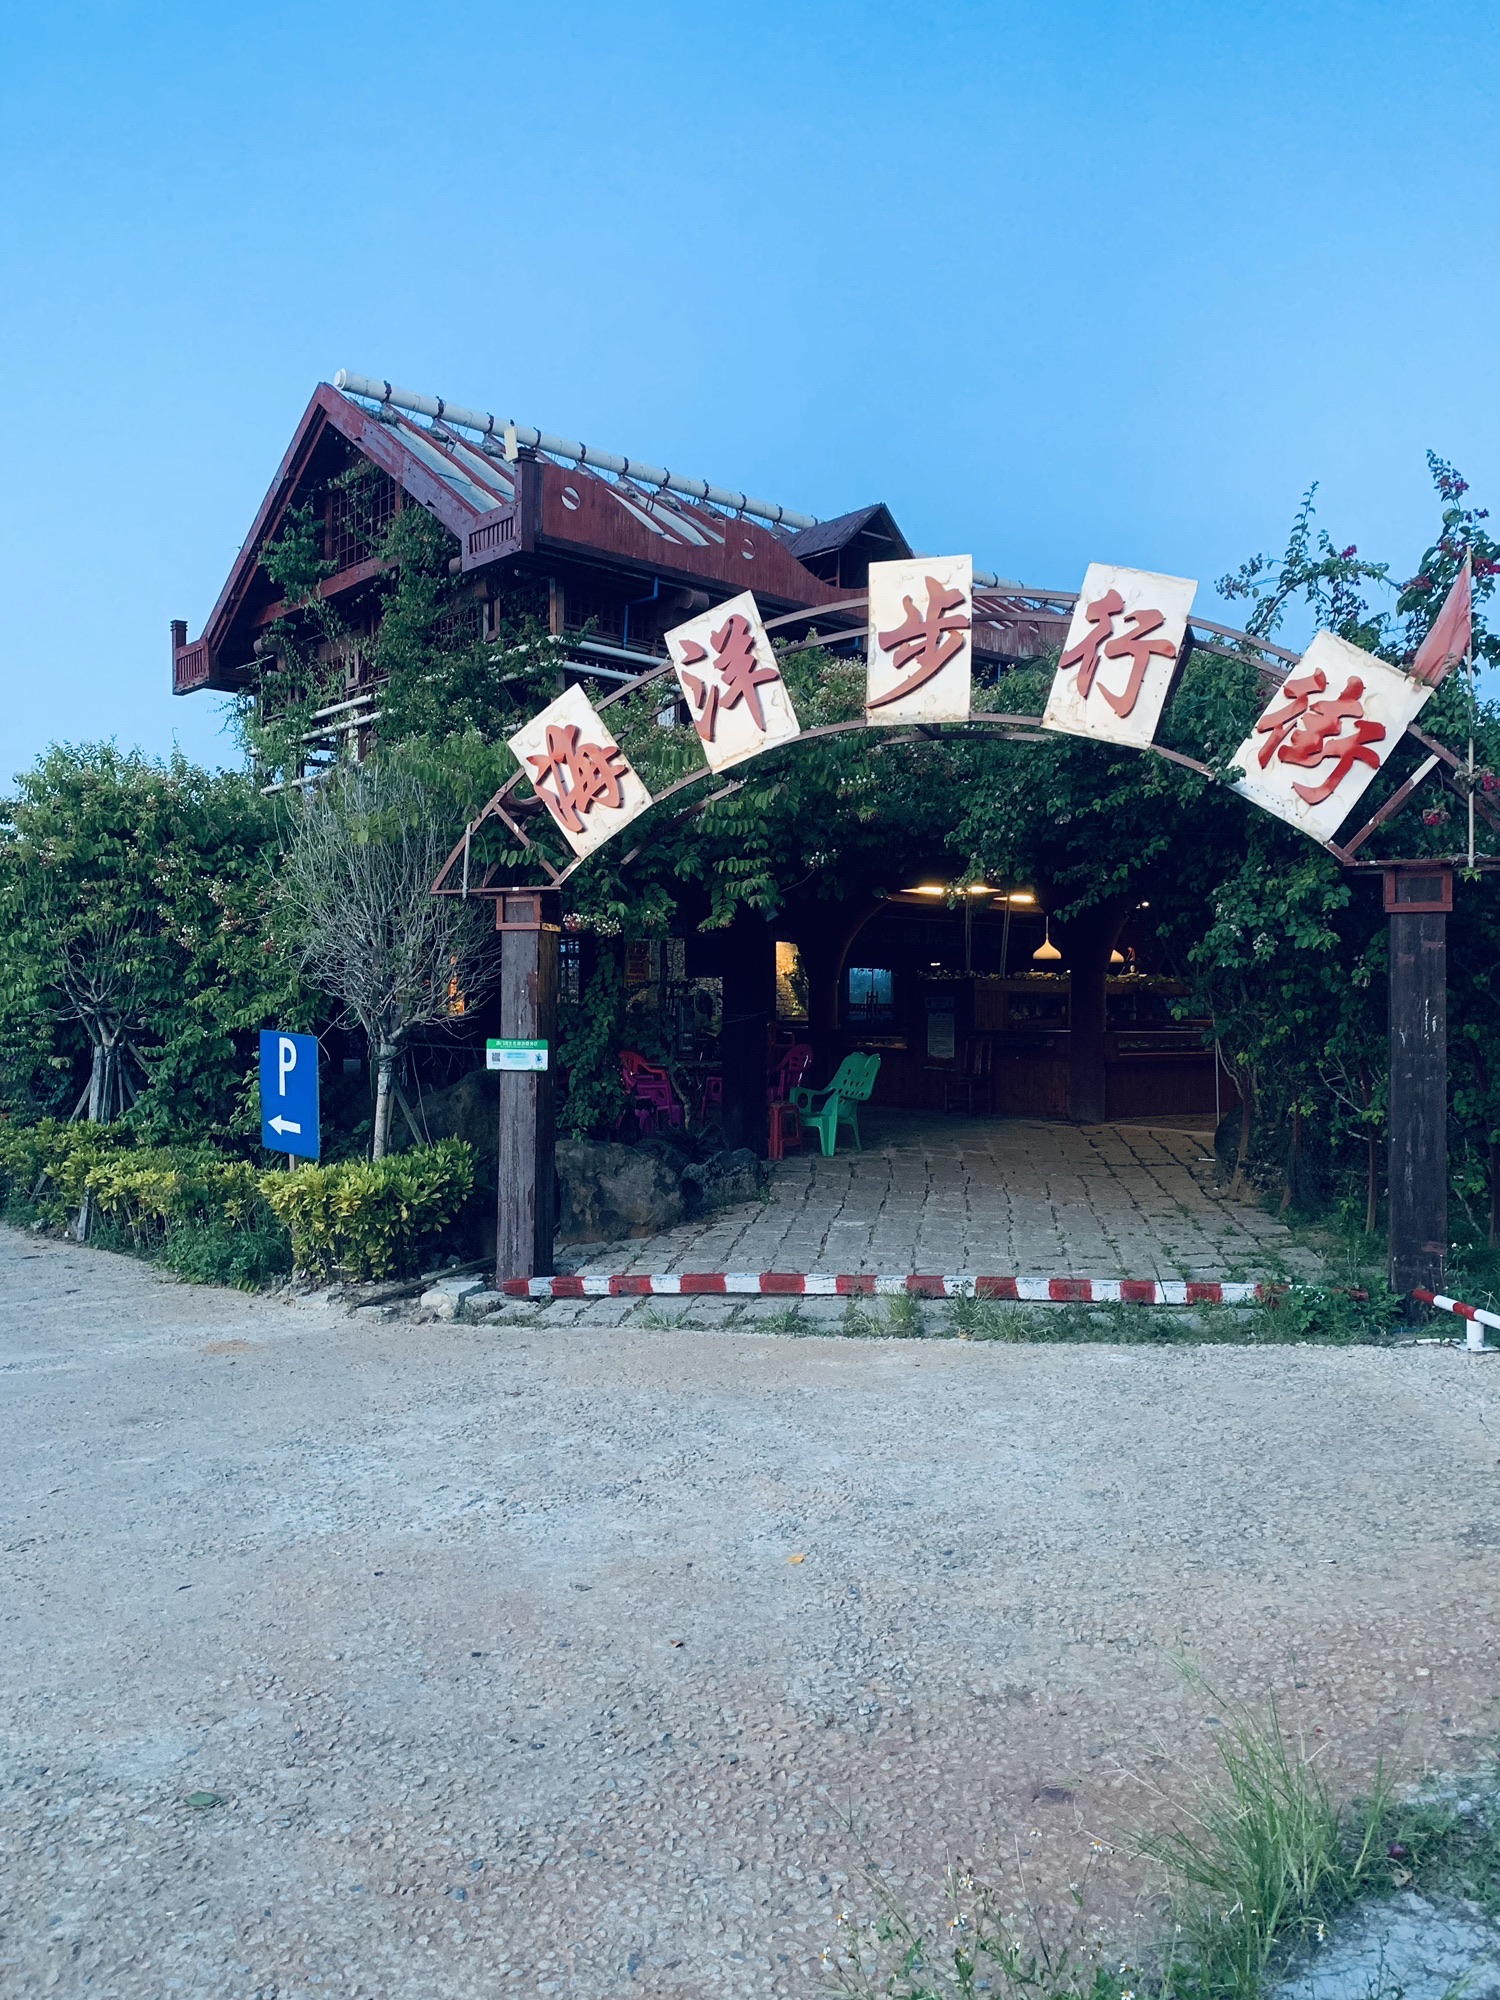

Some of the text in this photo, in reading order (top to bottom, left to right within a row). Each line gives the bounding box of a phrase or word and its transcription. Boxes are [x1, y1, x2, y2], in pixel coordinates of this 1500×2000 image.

[526, 575, 1387, 834] 海洋步行街
[278, 1036, 298, 1097] P
